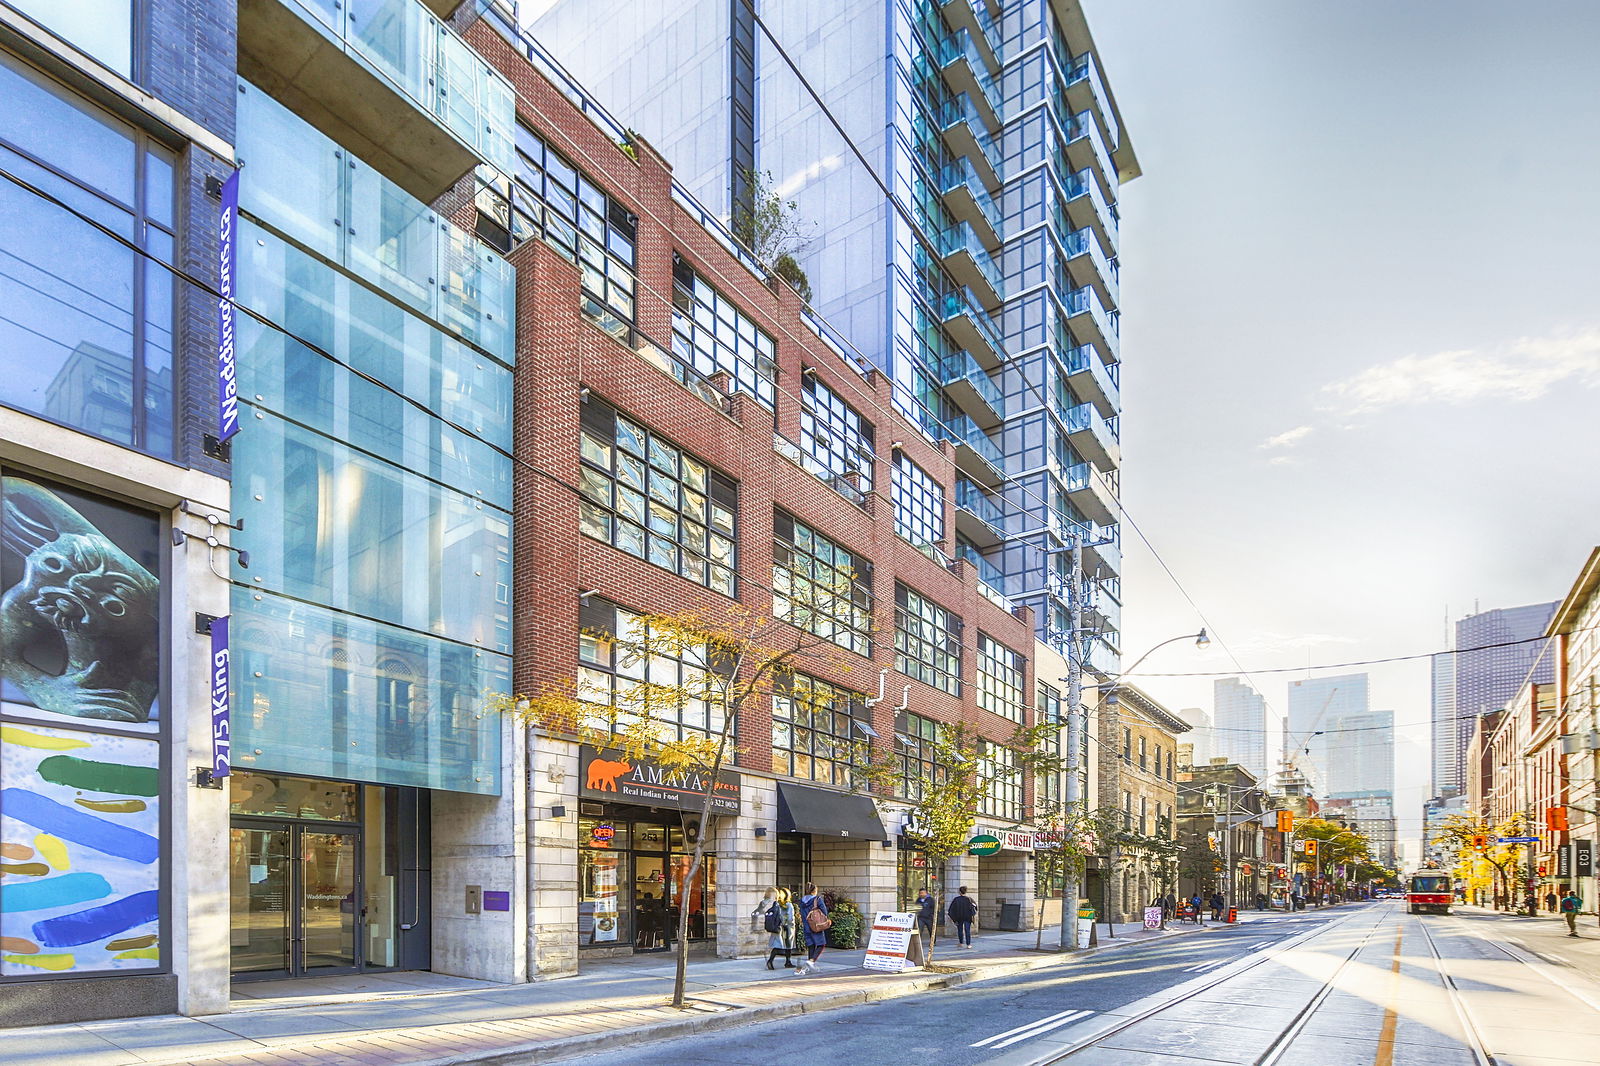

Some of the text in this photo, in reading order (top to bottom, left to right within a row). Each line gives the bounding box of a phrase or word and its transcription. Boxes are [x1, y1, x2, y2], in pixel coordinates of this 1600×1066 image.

[219, 206, 238, 433] Waddingtons.ca
[212, 648, 231, 771] 275 King
[631, 764, 739, 792] AMAYA epress
[623, 786, 679, 801] Real Indian Food
[594, 828, 614, 838] OPEN
[1008, 833, 1031, 848] SUSHI
[969, 841, 999, 849] SUBWAY
[1579, 849, 1590, 866] EQ3
